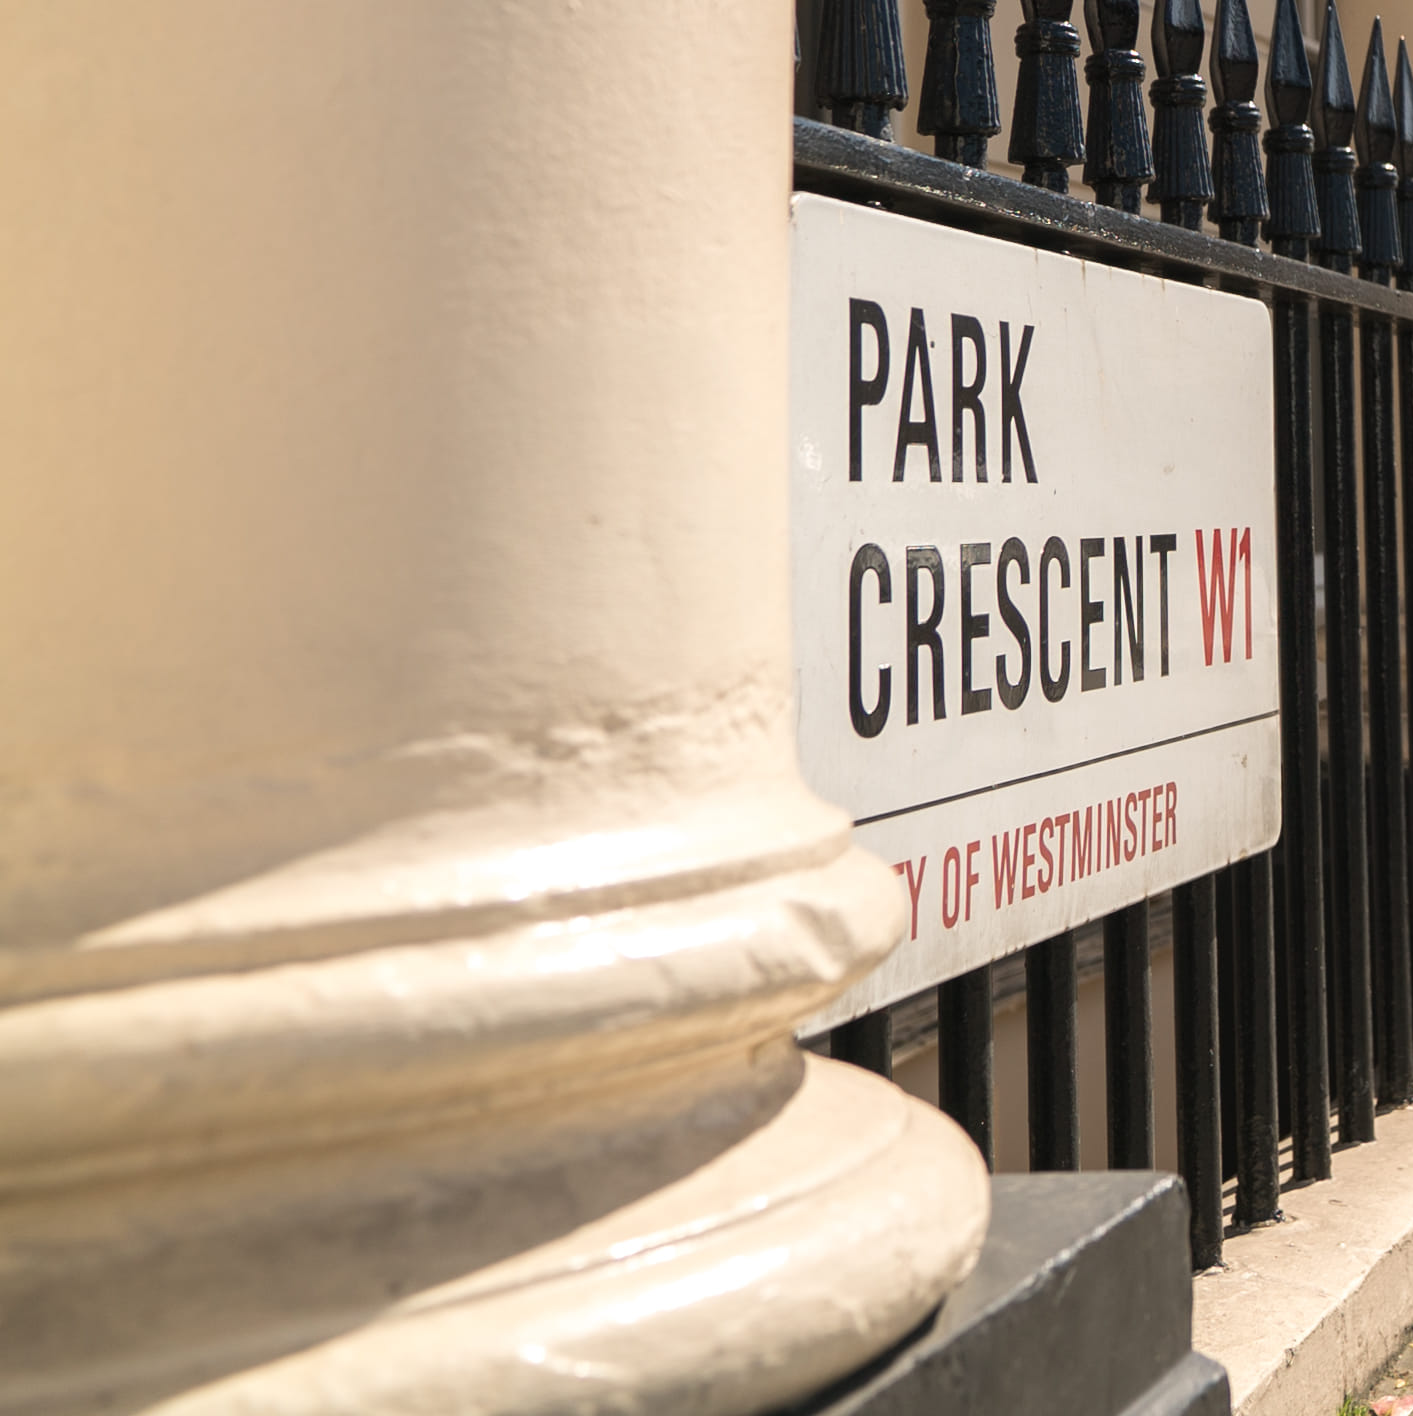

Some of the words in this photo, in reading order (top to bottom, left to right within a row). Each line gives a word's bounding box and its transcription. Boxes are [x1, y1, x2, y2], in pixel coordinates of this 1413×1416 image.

[849, 297, 1038, 483] PARK
[849, 534, 1177, 738] CRESCENT
[1195, 527, 1252, 666] W1
[942, 840, 980, 929] OF
[992, 781, 1177, 910] WESTMINSTER
